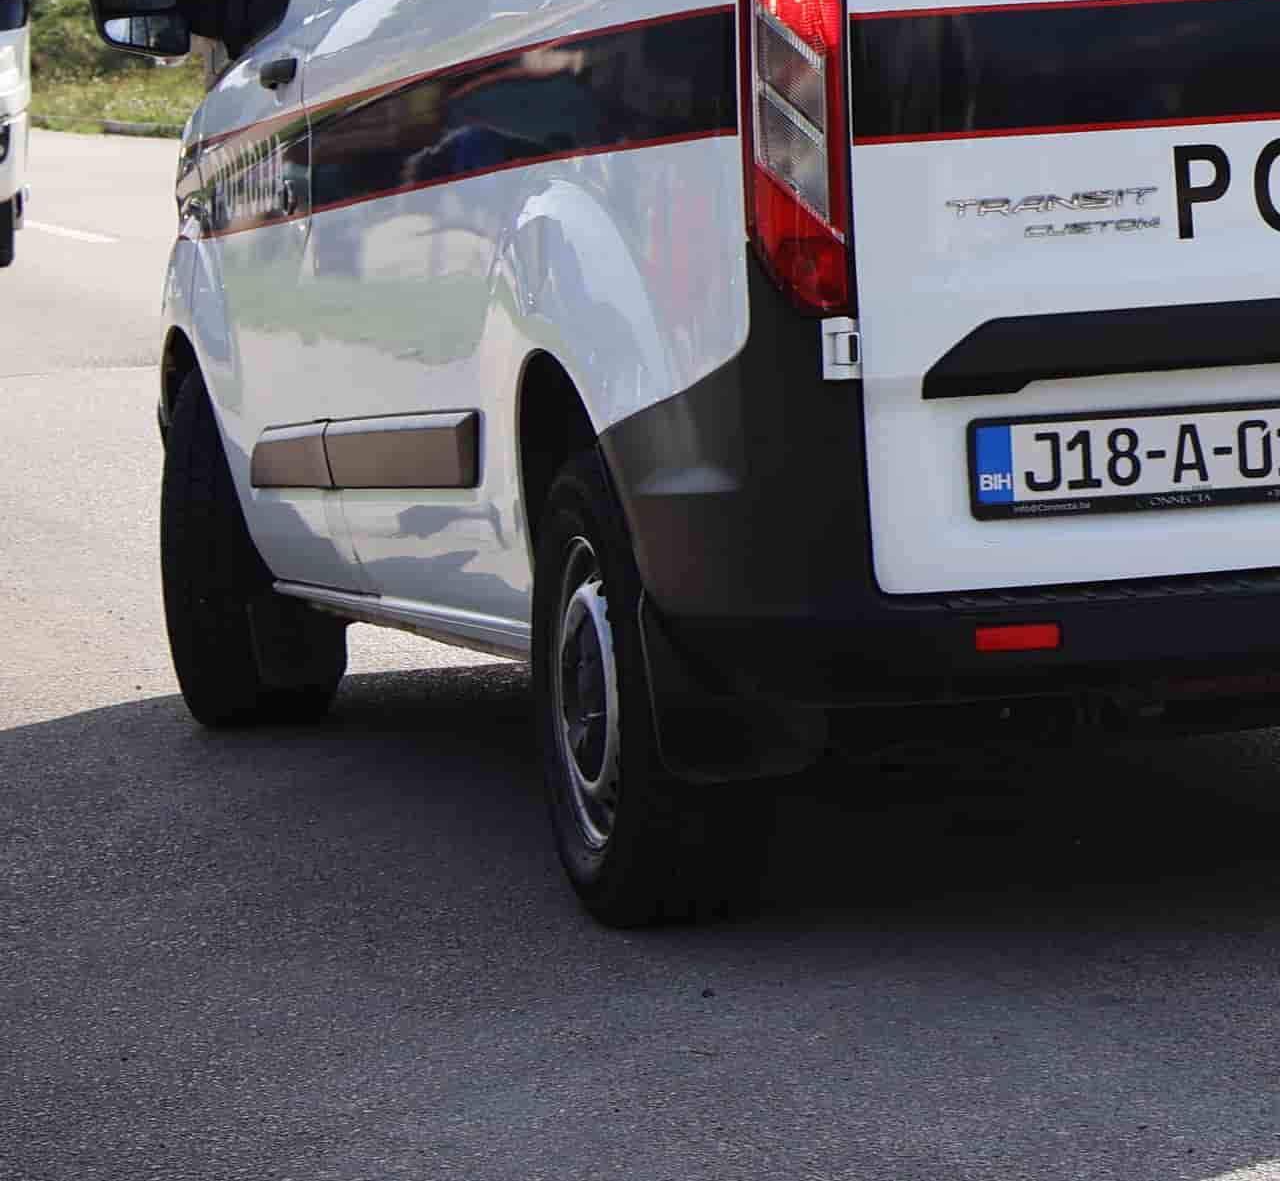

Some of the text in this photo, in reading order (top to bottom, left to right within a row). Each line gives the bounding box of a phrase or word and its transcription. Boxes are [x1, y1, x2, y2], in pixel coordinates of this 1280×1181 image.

[945, 186, 1159, 218] TRANSIT
[1024, 217, 1160, 237] CUSTOM
[979, 473, 1011, 491] BIH
